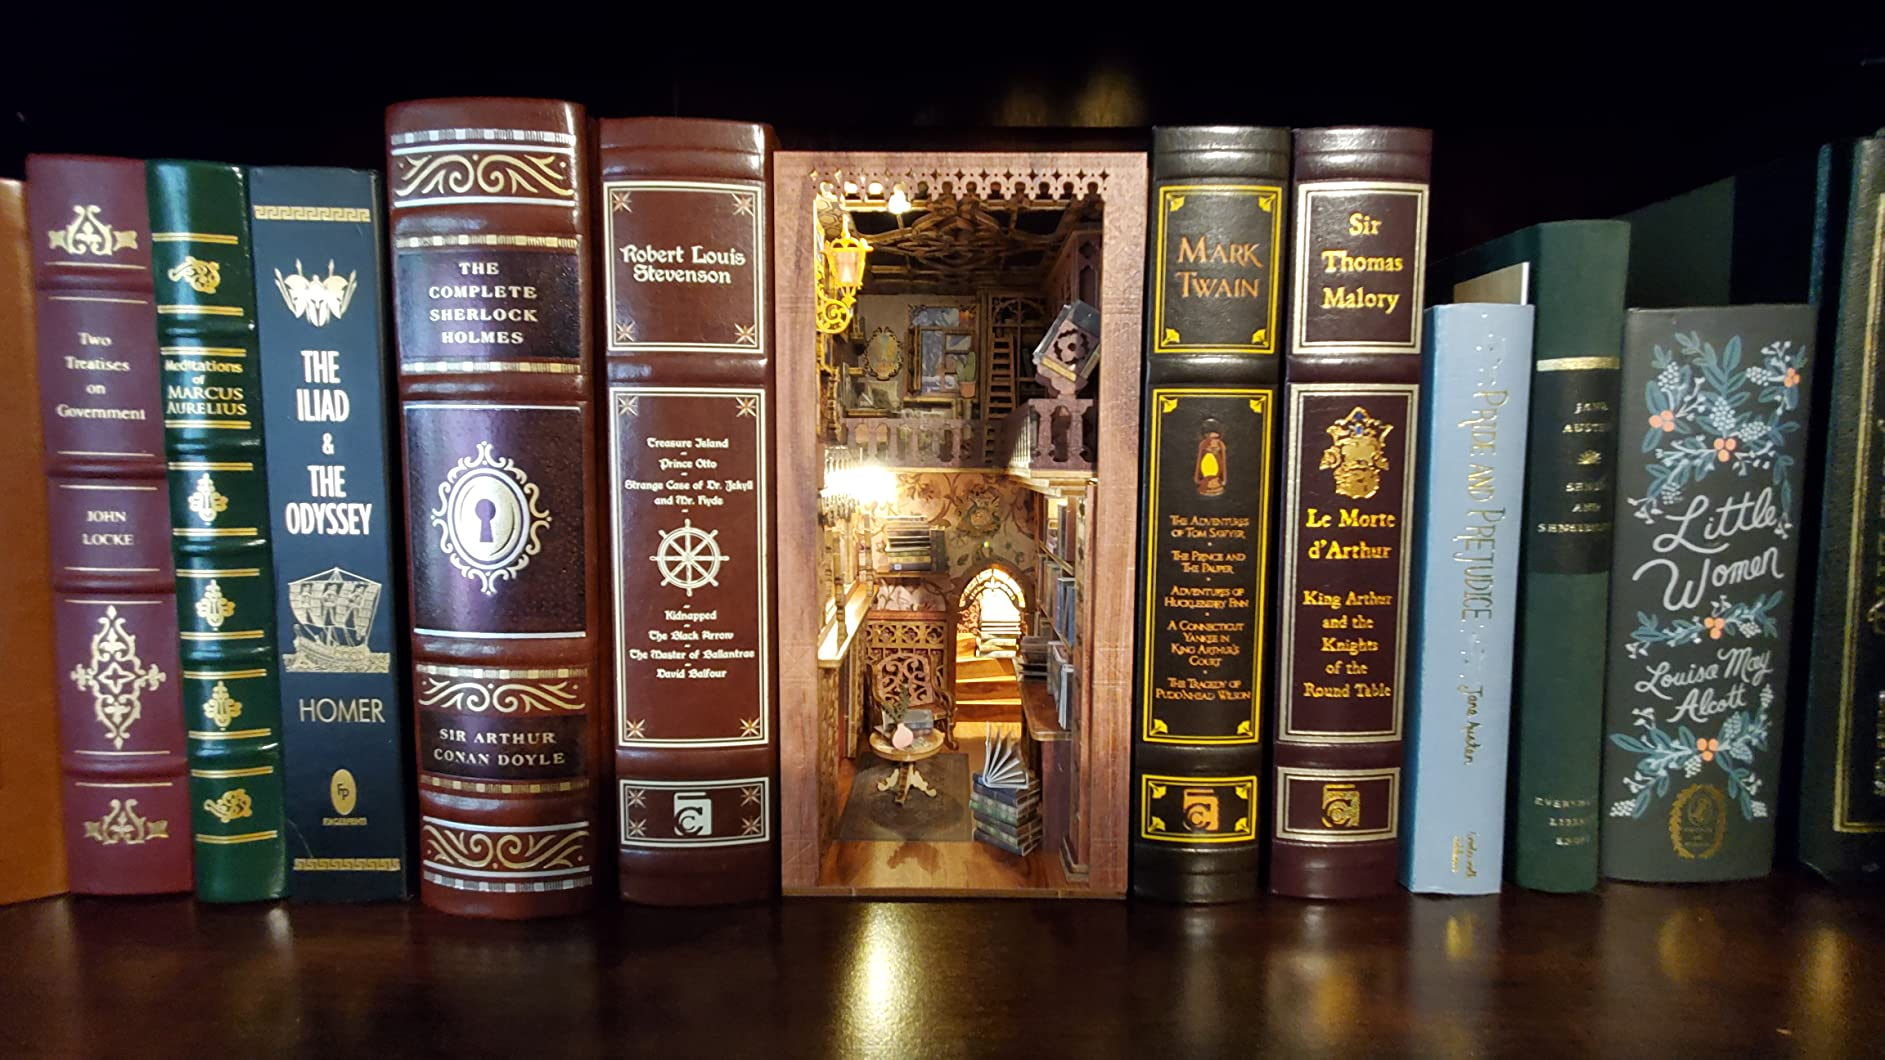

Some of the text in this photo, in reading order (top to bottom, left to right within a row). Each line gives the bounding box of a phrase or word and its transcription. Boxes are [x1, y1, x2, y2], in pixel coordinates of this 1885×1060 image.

[1349, 213, 1381, 236] Sir
[620, 244, 746, 266] Robert Louis
[1177, 236, 1263, 268] MARK
[1321, 250, 1403, 273] Thomas
[459, 262, 499, 275] THE
[633, 264, 732, 284] Stevenson
[1175, 271, 1260, 298] TWAIN
[428, 286, 538, 299] COMPLETE
[1320, 287, 1400, 314] Malory
[429, 309, 538, 322] SHERLOCK
[77, 332, 111, 346] Two
[442, 332, 524, 344] HOLMES
[64, 356, 130, 372] Treatises
[165, 360, 243, 373] Meditations
[301, 351, 340, 383] THE
[192, 375, 206, 384] of
[86, 382, 106, 395] on
[168, 385, 244, 400] MARCUS
[166, 402, 247, 415] AURELIUS
[296, 389, 349, 422] ILIAD
[56, 404, 146, 421] Government
[322, 432, 334, 454] &
[647, 438, 729, 448] Treasure Island
[659, 459, 717, 471] Prince Otto
[308, 466, 346, 497] THE
[625, 480, 753, 492] Strange Case of Dr. Jekyll
[654, 495, 723, 507] and Mr. Hyde
[86, 510, 127, 523] JOHN
[285, 503, 372, 535] ODYSSEY
[1170, 515, 1249, 527] THE ADVENTURES
[1305, 509, 1396, 528] Le Morte
[1652, 486, 1777, 555] Little
[82, 533, 135, 546] LOCKE
[1185, 527, 1206, 537] TOM
[1209, 528, 1246, 539] SAWYER
[1171, 550, 1246, 562] THE PRINCE AND
[1181, 562, 1235, 574] THE PAUPER
[1631, 545, 1785, 612] Women
[1170, 586, 1230, 597] ADVENTURES
[1164, 597, 1249, 609] HUCKLEBERRY FINN
[1303, 591, 1393, 610] King Arthur
[664, 610, 717, 622] Kidnapped
[1322, 615, 1374, 629] and the
[1167, 620, 1245, 631] A CONNECTICUT
[648, 631, 734, 642] The Black Arrow
[1183, 632, 1218, 643] YANKEE
[1171, 643, 1195, 655] KING
[1321, 638, 1379, 656] Knights
[629, 649, 755, 660] The Master of Ballantrae
[1189, 656, 1222, 667] COURT
[1325, 660, 1368, 675] of the
[656, 669, 727, 678] David Balfour
[1634, 647, 1774, 701] Louisa May
[1167, 678, 1242, 689] THE TRAGEDY OF
[1217, 690, 1251, 699] WILSON
[1303, 683, 1392, 698] Round Table
[300, 697, 385, 723] HOMER
[1666, 683, 1748, 724] Alcott
[1457, 685, 1484, 765] Jane Austen
[439, 728, 557, 744] SIR ARTHUR
[433, 748, 565, 766] CONAN DOYLE
